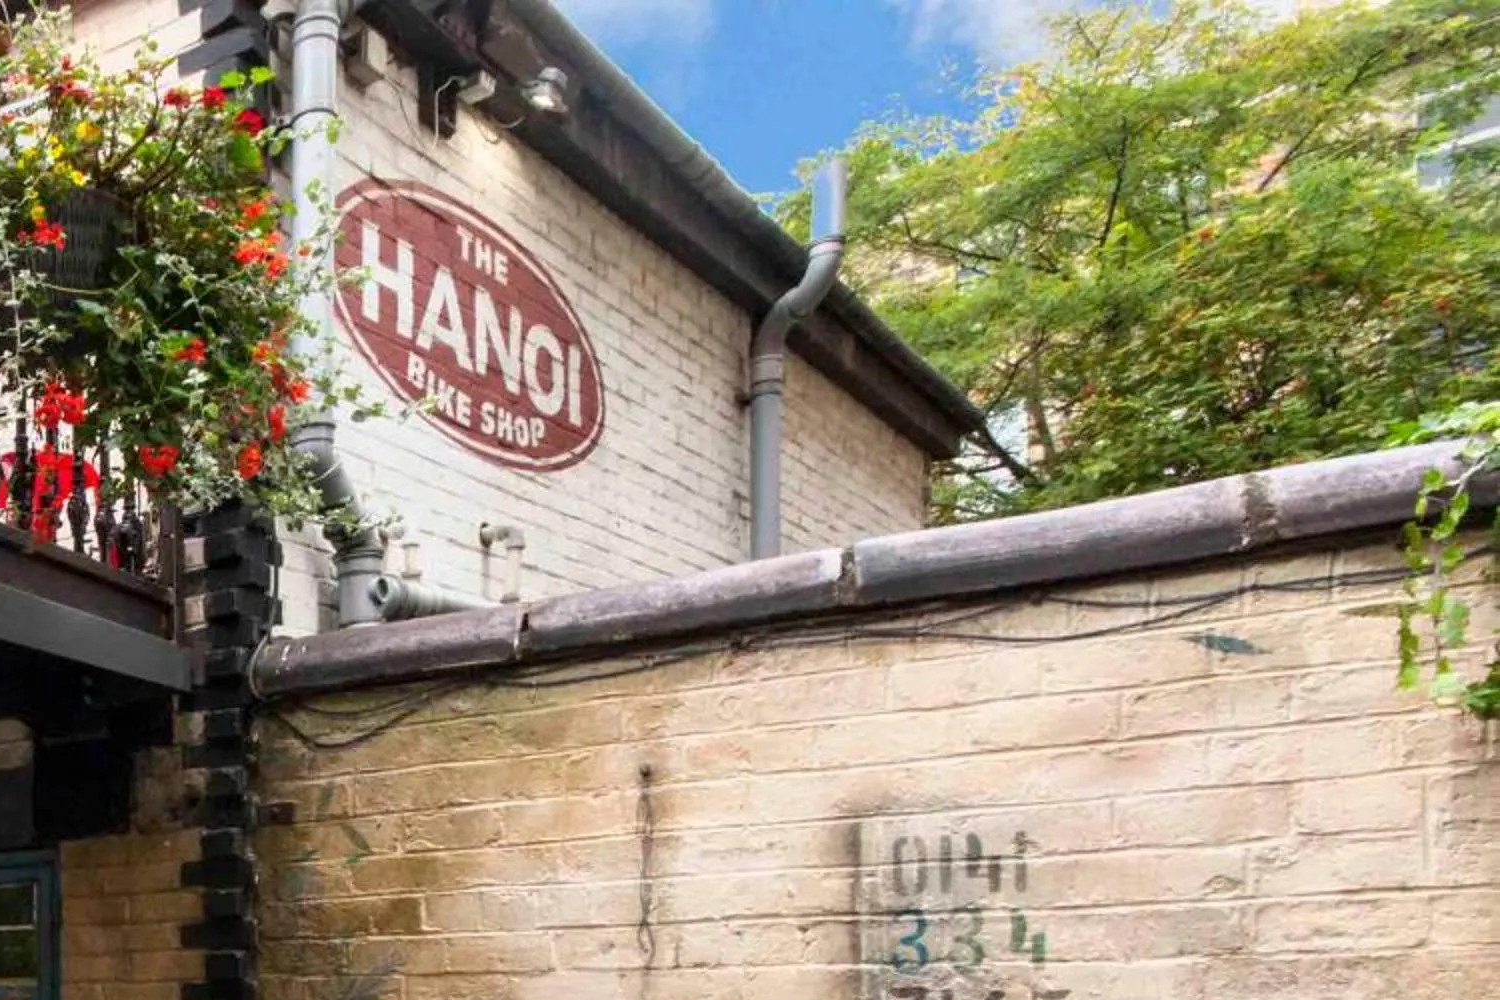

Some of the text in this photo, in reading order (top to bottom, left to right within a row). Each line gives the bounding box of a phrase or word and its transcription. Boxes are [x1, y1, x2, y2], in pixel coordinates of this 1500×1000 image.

[457, 224, 509, 286] THE
[360, 221, 583, 429] HANOI
[407, 351, 546, 449] BIKE SHOP
[891, 906, 1046, 974] 334
